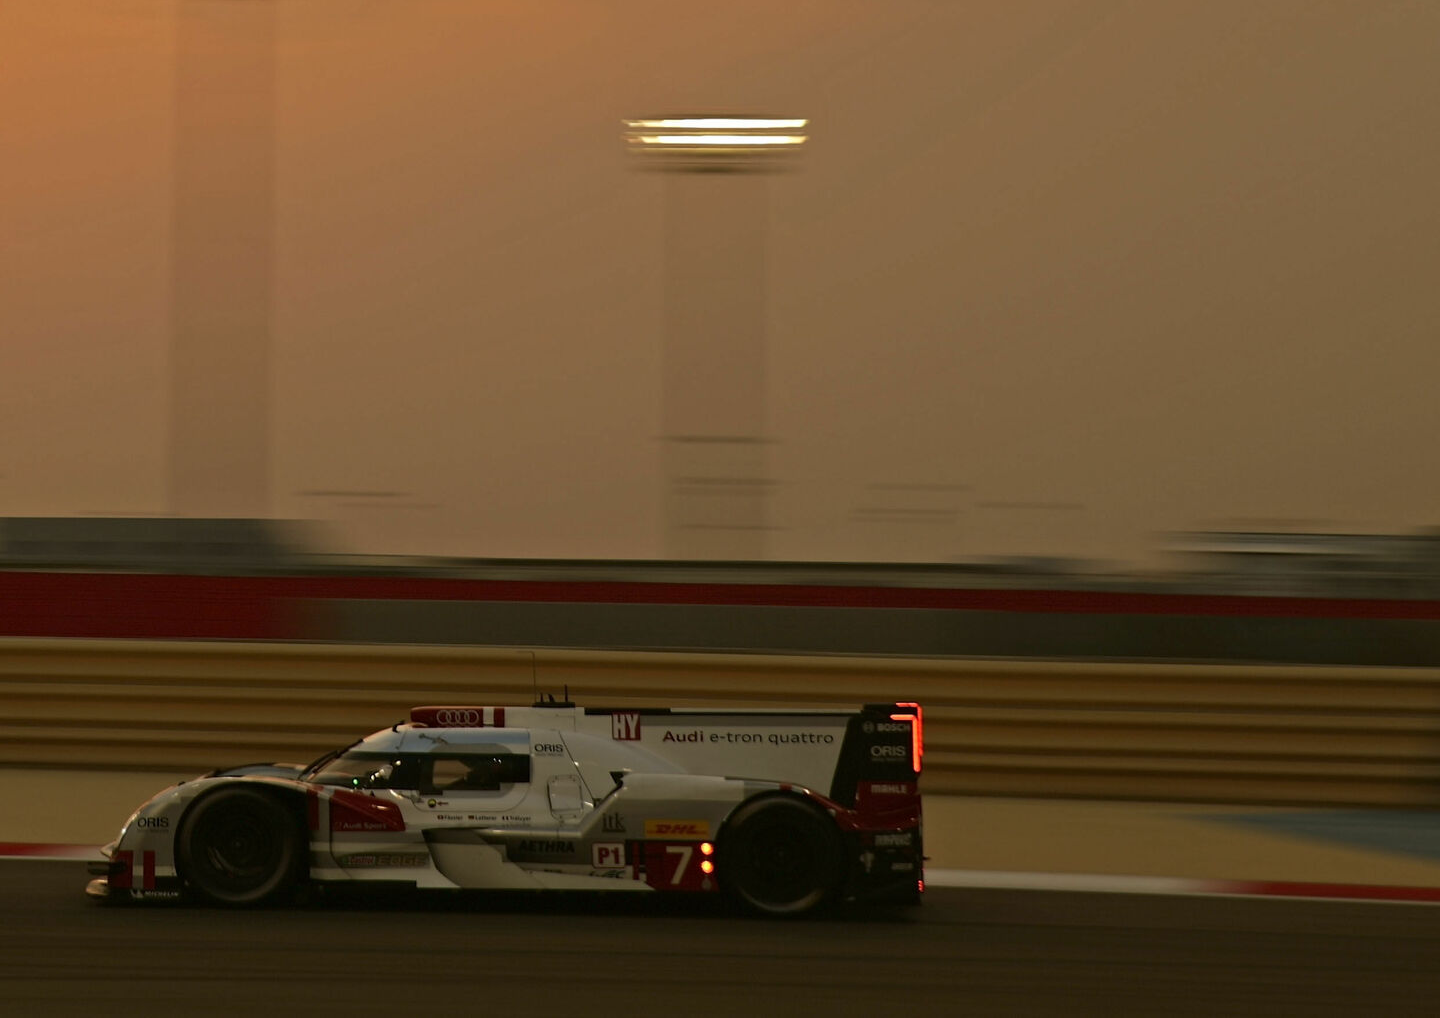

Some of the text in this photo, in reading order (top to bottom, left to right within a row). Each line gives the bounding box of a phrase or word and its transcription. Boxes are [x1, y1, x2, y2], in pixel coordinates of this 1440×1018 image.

[613, 713, 640, 740] HY
[876, 723, 911, 732] BOSCH
[663, 730, 834, 746] Audi e-tron quattro
[534, 743, 564, 753] ORIS
[870, 745, 907, 757] ORIS
[871, 784, 907, 794] MAHLE
[137, 817, 169, 828] ORIS
[519, 840, 575, 854] AETHRA
[598, 848, 621, 864] P1
[665, 845, 694, 885] 7
